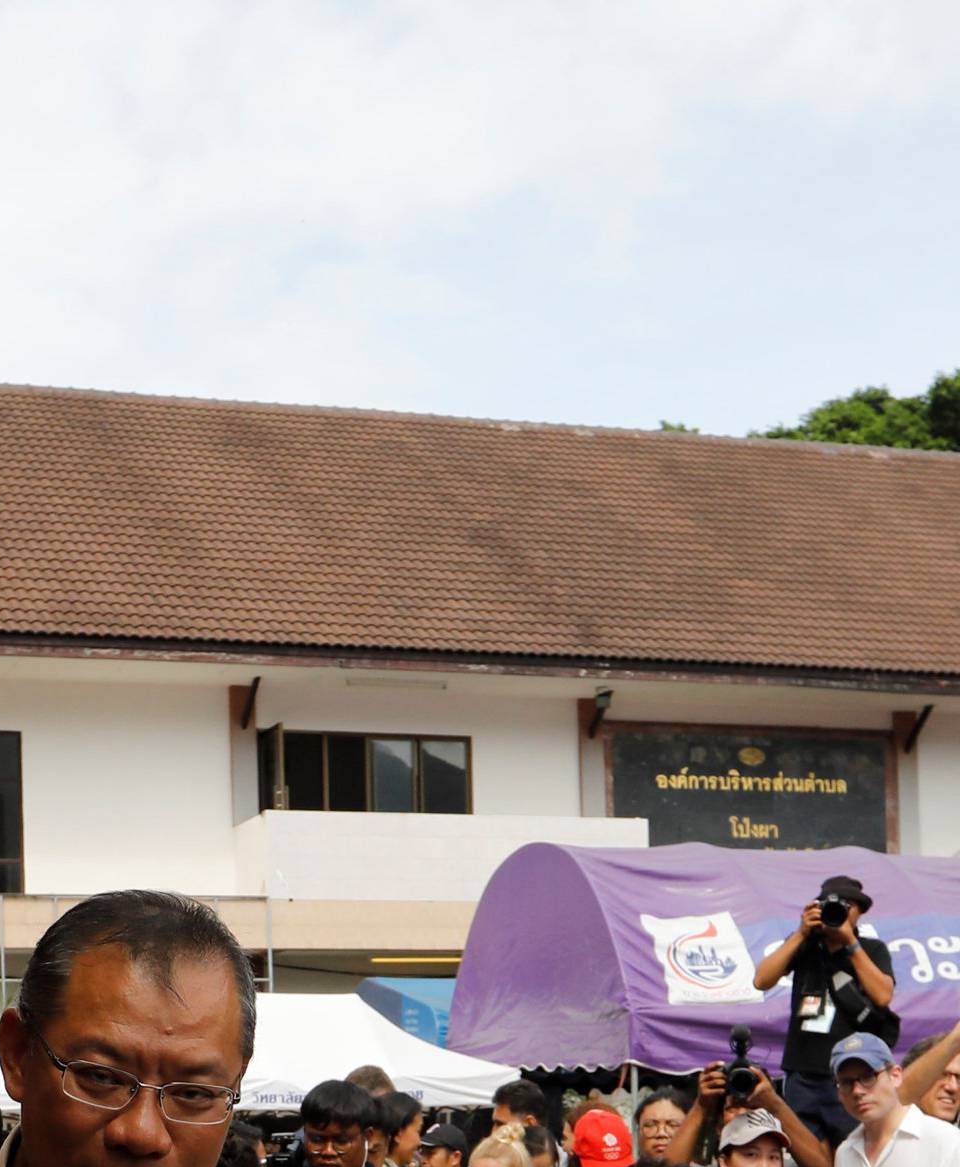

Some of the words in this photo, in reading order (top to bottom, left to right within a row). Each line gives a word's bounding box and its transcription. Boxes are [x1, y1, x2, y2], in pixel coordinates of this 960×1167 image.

[655, 767, 848, 794] องค์การบริหารส่วนตำบล
